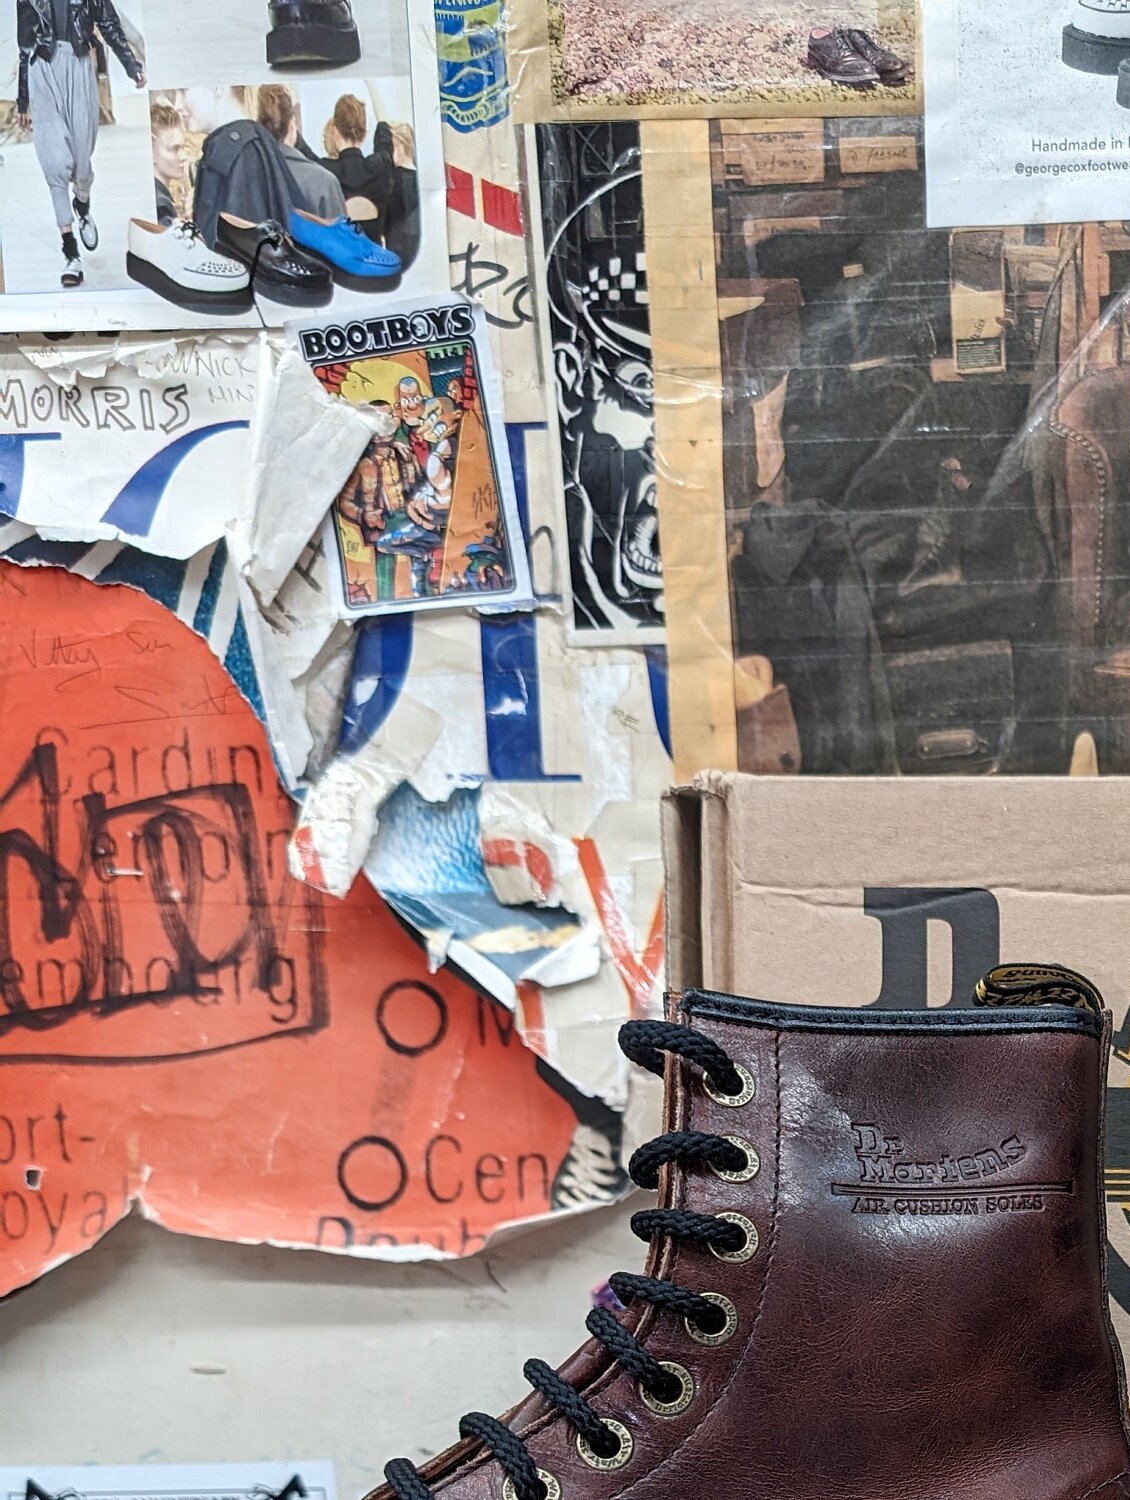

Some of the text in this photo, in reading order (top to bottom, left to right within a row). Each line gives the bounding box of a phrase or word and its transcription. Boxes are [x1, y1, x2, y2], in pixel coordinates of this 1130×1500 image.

[1031, 137, 1106, 152] Handmade
[1111, 137, 1123, 150] in
[301, 305, 474, 361] BOOTBOYS
[850, 1121, 905, 1156] Dr
[857, 1134, 1027, 1184] Martens
[851, 1194, 1045, 1215] AIR CUSHION SOLES
